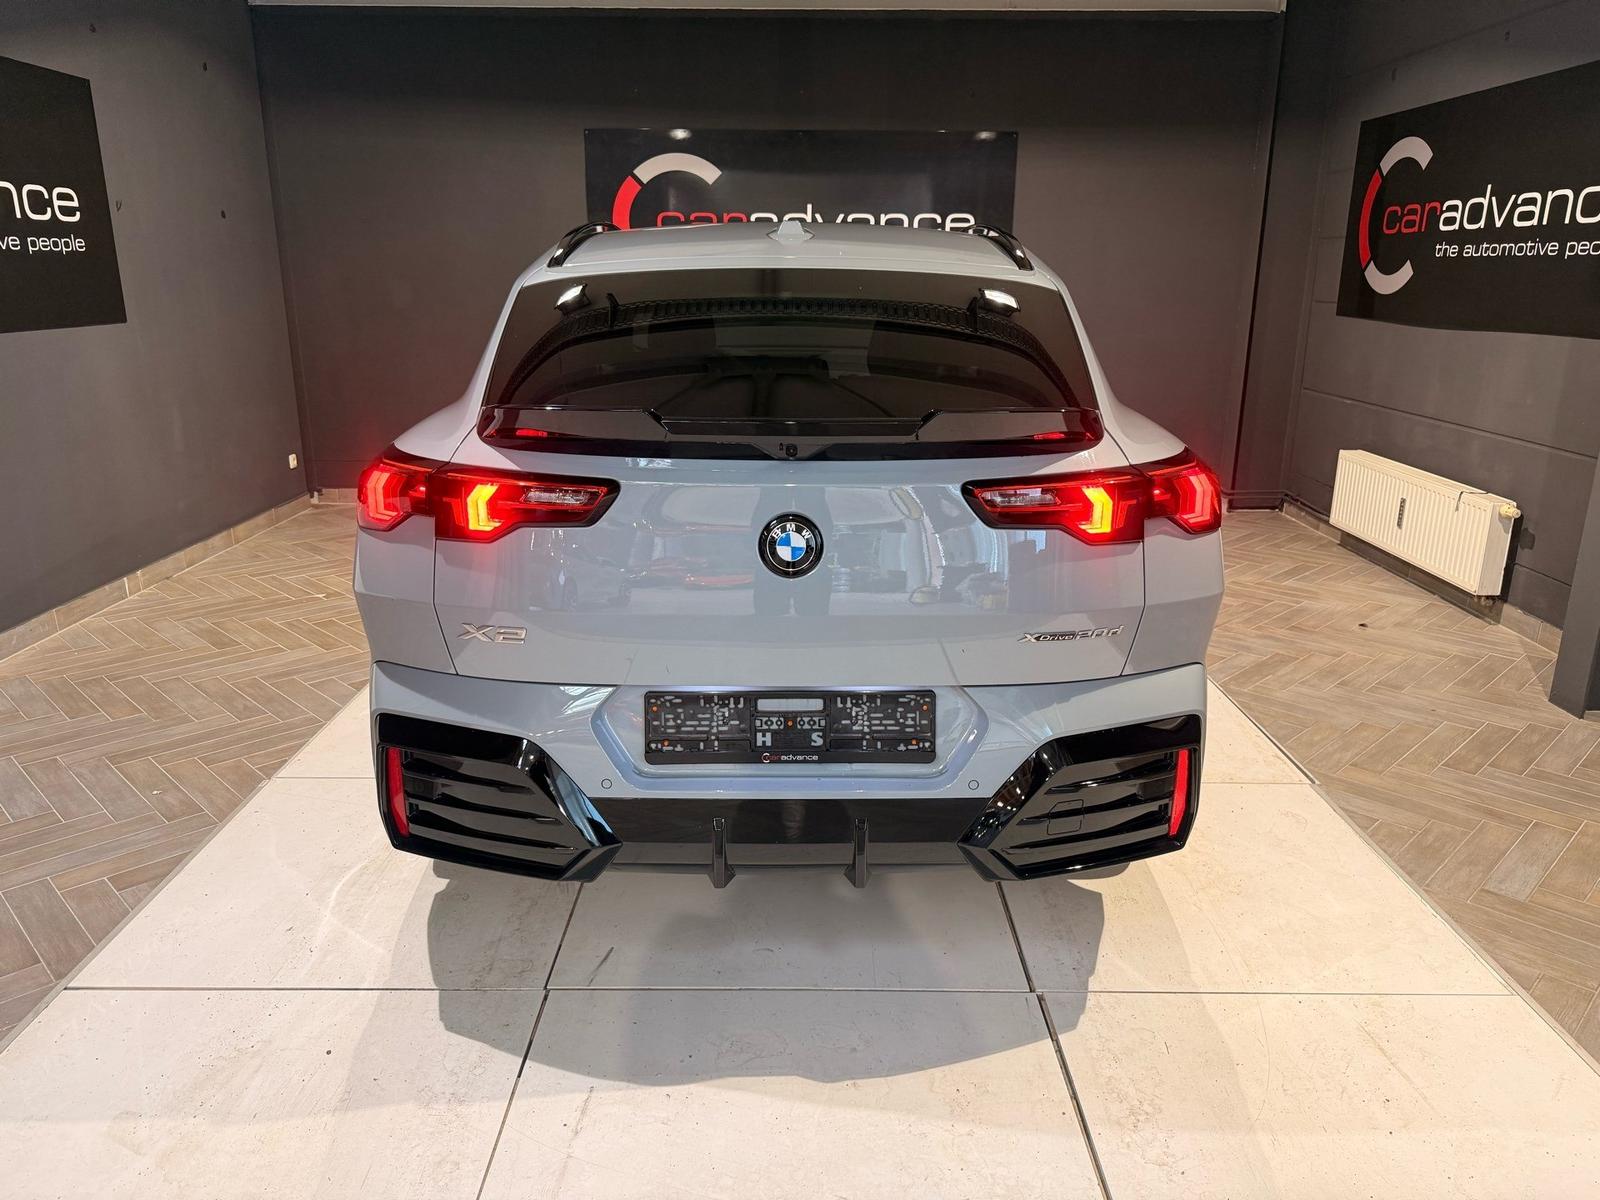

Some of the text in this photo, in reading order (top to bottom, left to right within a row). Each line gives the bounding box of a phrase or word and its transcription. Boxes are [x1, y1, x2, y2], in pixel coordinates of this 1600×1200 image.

[27, 234, 86, 254] people
[1435, 241, 1459, 257] the
[1462, 238, 1559, 257] automotive
[771, 523, 812, 540] BMW
[457, 622, 527, 644] X2
[756, 732, 772, 747] H
[810, 732, 824, 746] S
